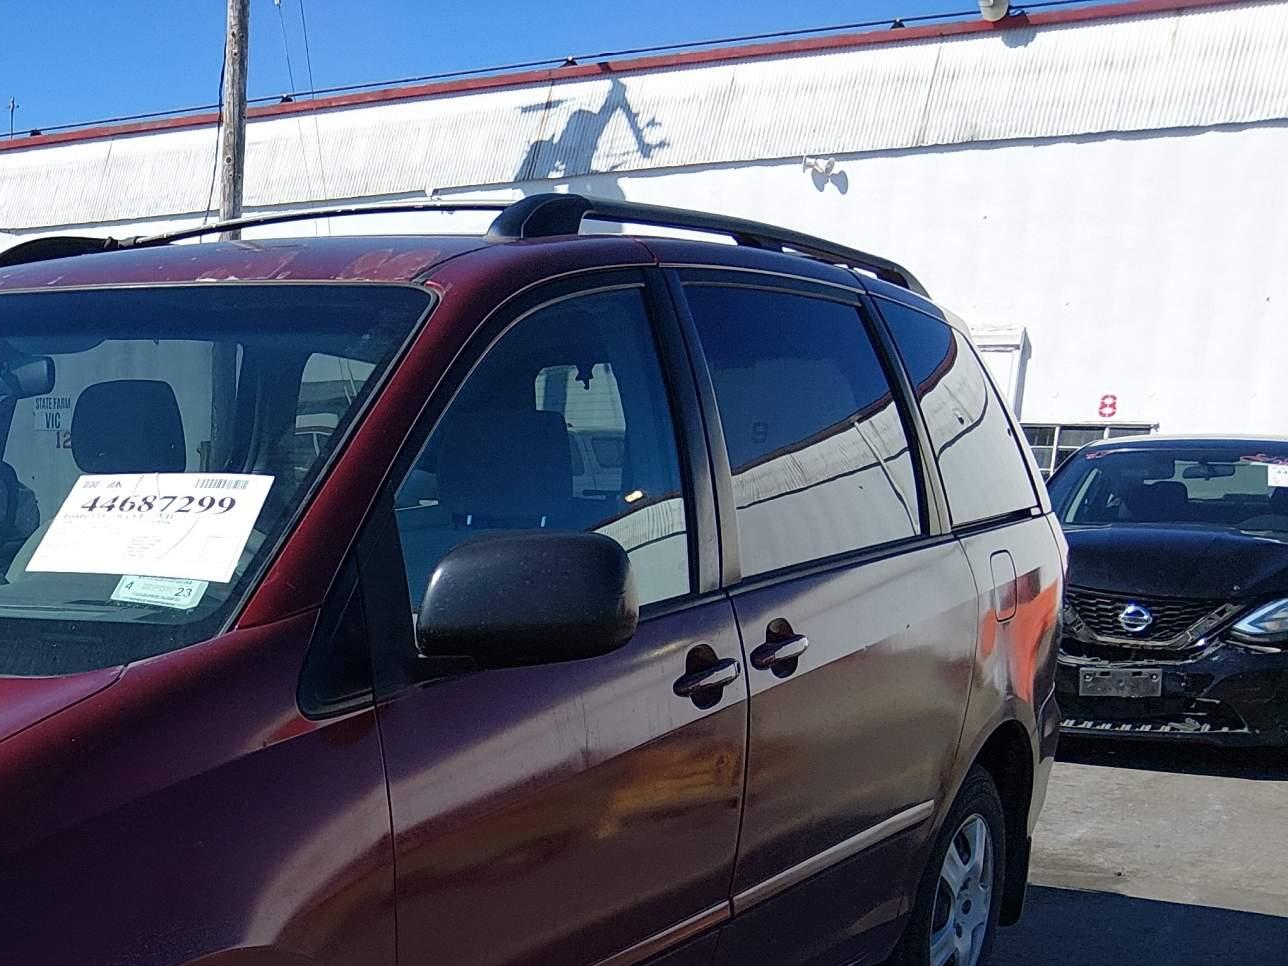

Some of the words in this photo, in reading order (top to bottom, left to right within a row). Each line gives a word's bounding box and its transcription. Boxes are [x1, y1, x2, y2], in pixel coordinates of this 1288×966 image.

[35, 397, 52, 410] STATE
[53, 397, 71, 409] FARM
[1098, 394, 1117, 418] 8
[45, 411, 61, 429] VIC
[56, 431, 72, 449] 12
[80, 495, 236, 515] 44687299
[174, 587, 193, 598] 23
